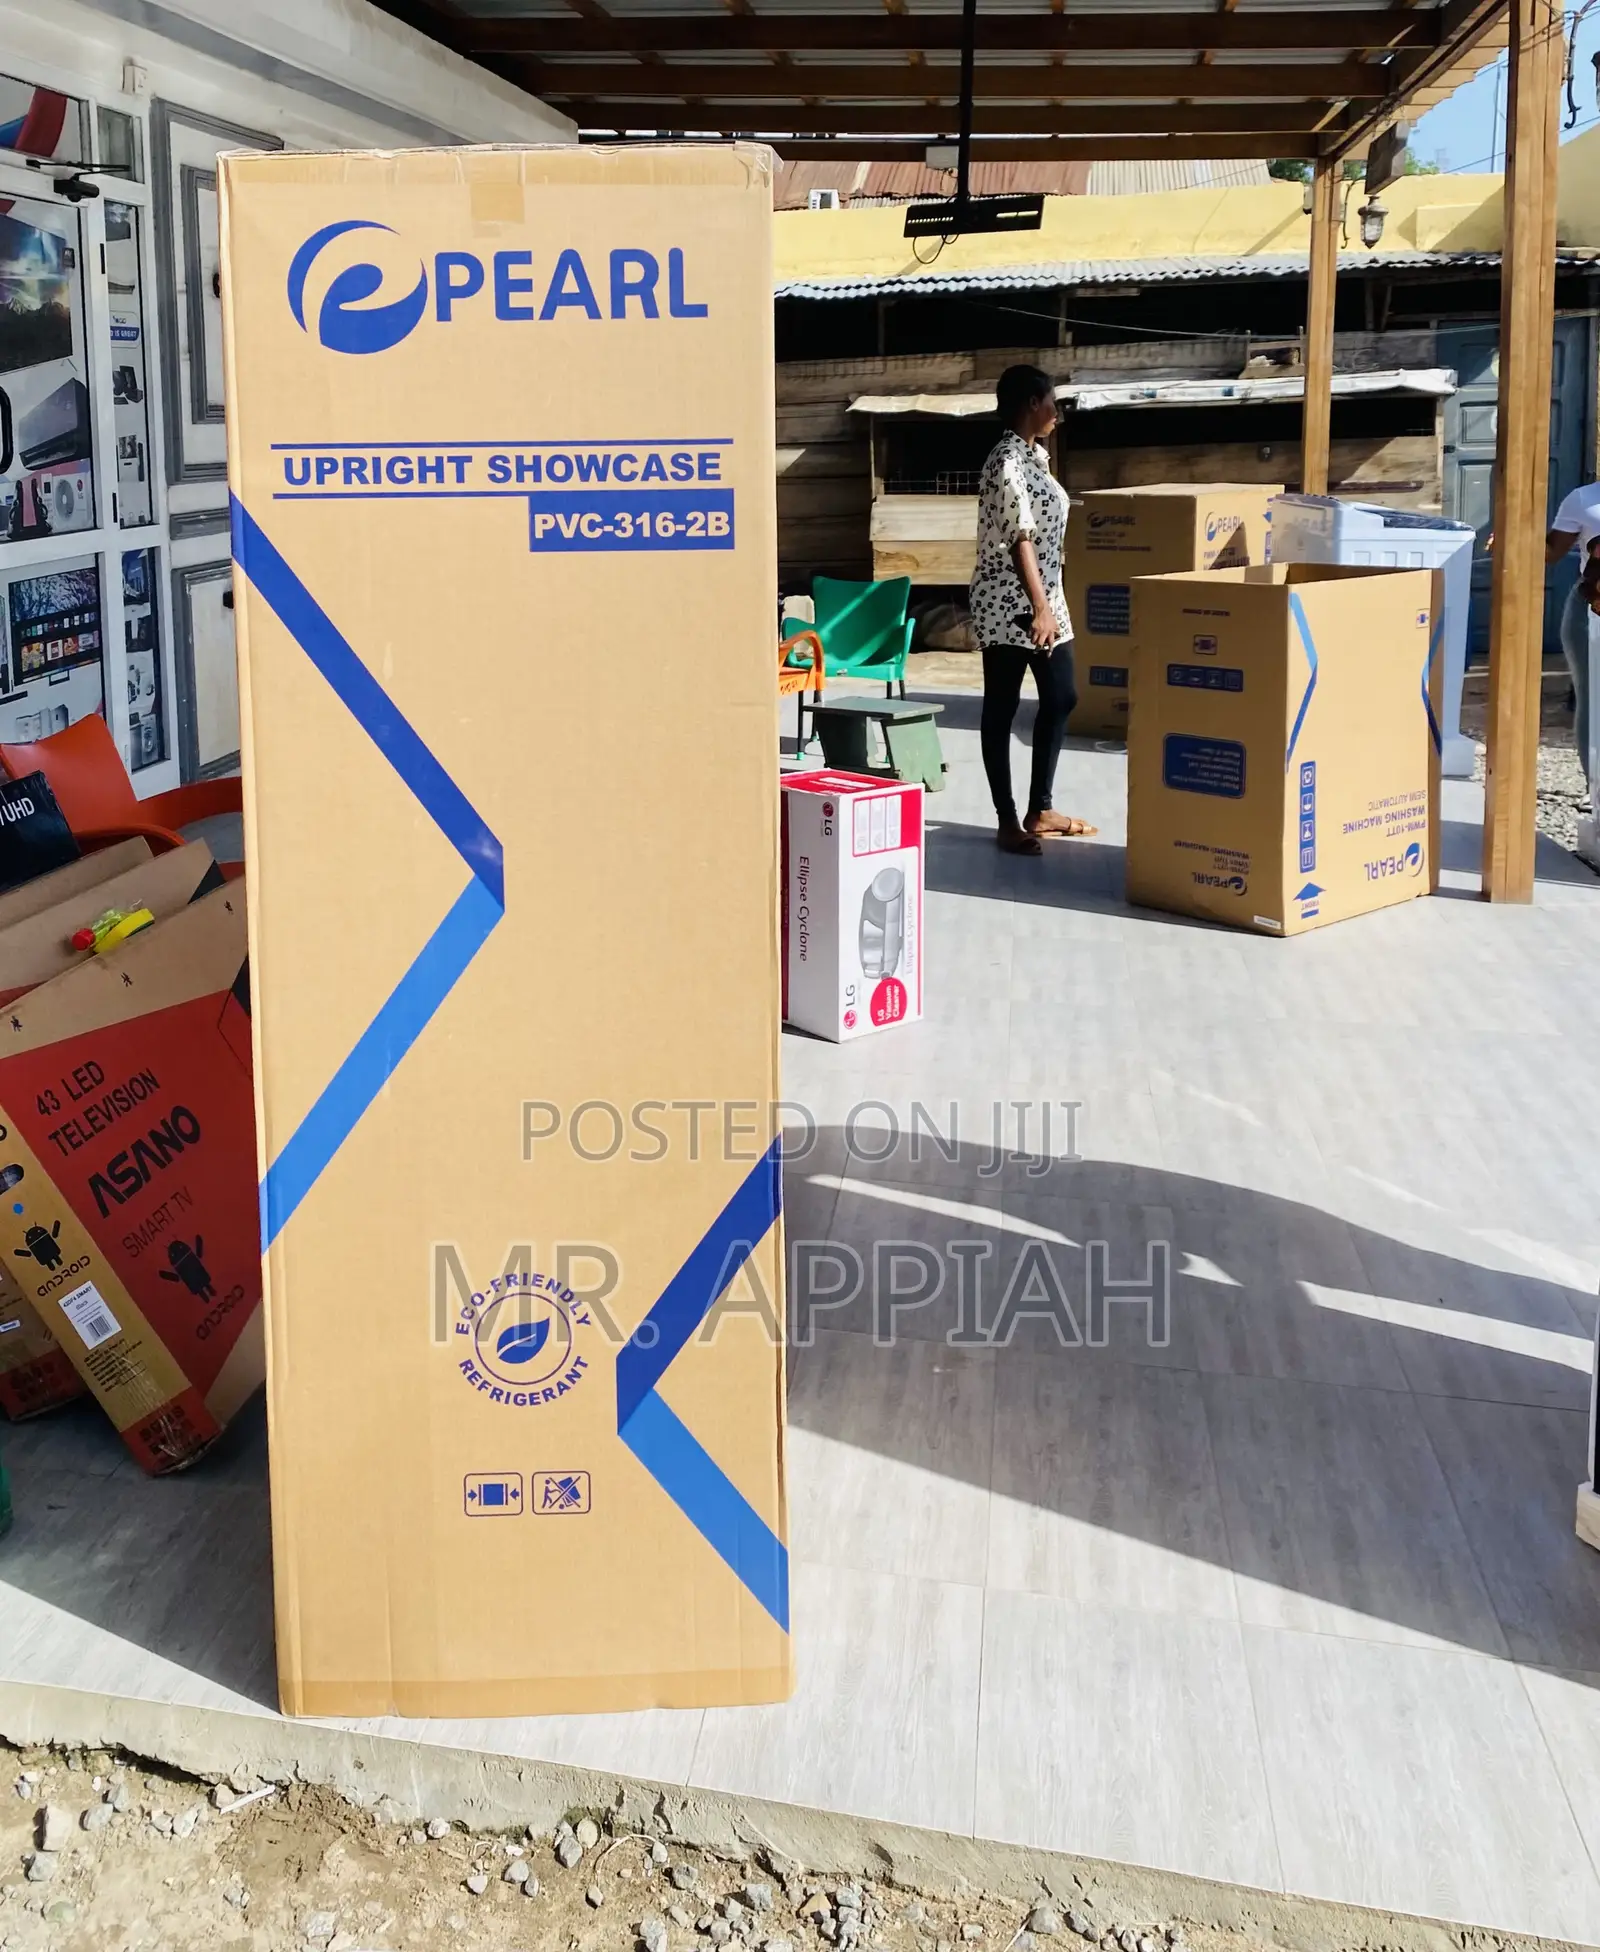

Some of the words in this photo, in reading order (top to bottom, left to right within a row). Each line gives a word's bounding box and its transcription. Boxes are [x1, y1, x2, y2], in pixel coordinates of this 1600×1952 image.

[434, 247, 709, 322] PEARL
[283, 455, 473, 486] UPRIGHT
[487, 452, 722, 484] SHOWCASE
[534, 511, 731, 540] PVC-316-2B
[1216, 515, 1241, 534] PEARL
[1368, 794, 1408, 811] AUTOMATIC
[1408, 790, 1427, 802] SEMI
[824, 819, 833, 836] LG
[1342, 816, 1383, 834] MACHINE
[1384, 805, 1426, 824] WASHING
[1386, 819, 1426, 837] PWM-10TT
[796, 856, 810, 901] Ellipse
[1192, 871, 1231, 889] PEARL
[1364, 854, 1404, 881] PEARL
[796, 905, 810, 962] Cyclone
[845, 984, 856, 1006] LG
[884, 985, 892, 1020] Vacuum
[892, 984, 900, 1018] Cleaner
[877, 1009, 885, 1022] LG
[37, 1089, 61, 1116] 43
[61, 1060, 105, 1101] LED
[48, 1068, 160, 1156] TELEVISION
[87, 1104, 201, 1218] ASANO
[122, 1202, 175, 1258] SMART
[175, 1186, 194, 1218] TV
[37, 1255, 91, 1297] ANDROID
[196, 1284, 244, 1340] ANDROID
[455, 1272, 592, 1336] ECO-FRIENDLY
[458, 1355, 589, 1407] REFRIGERANT
